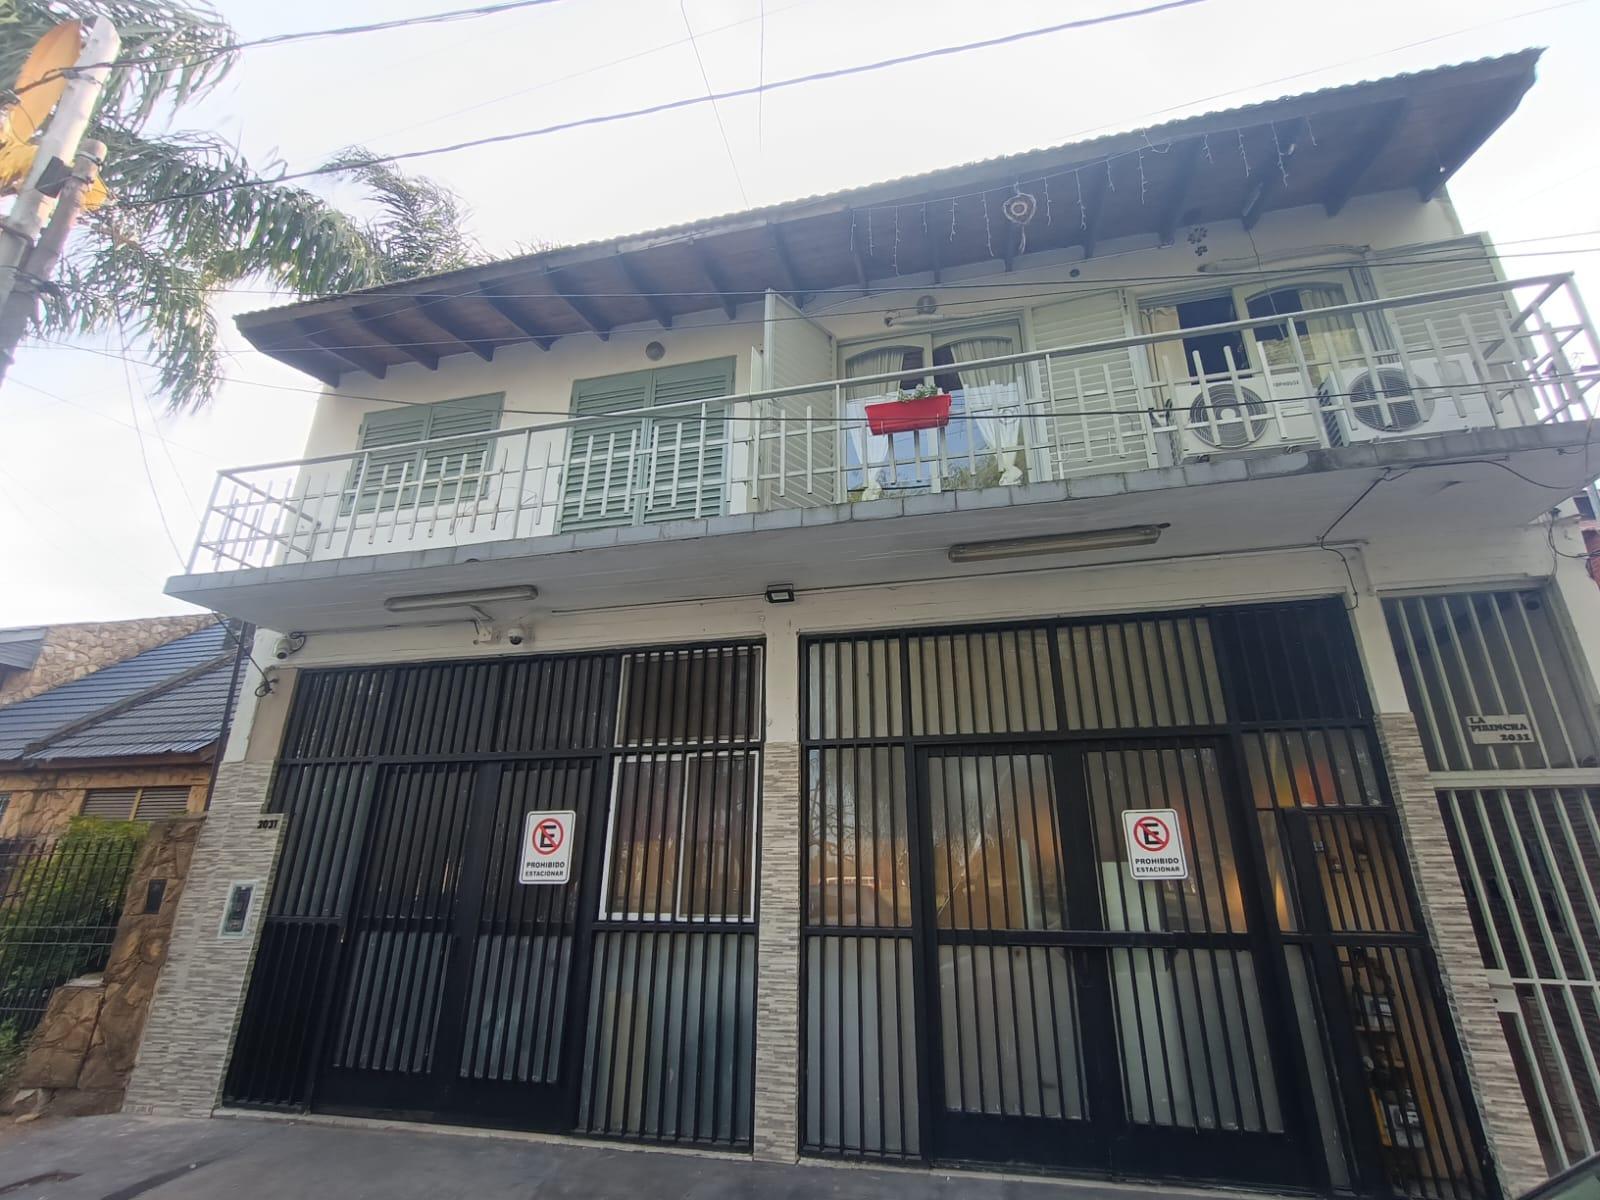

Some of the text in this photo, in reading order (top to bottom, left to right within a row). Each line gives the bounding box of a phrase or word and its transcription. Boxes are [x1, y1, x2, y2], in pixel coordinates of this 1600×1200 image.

[540, 825, 557, 848] E
[1142, 823, 1162, 845] E
[1135, 857, 1180, 865] PROHIBIDO
